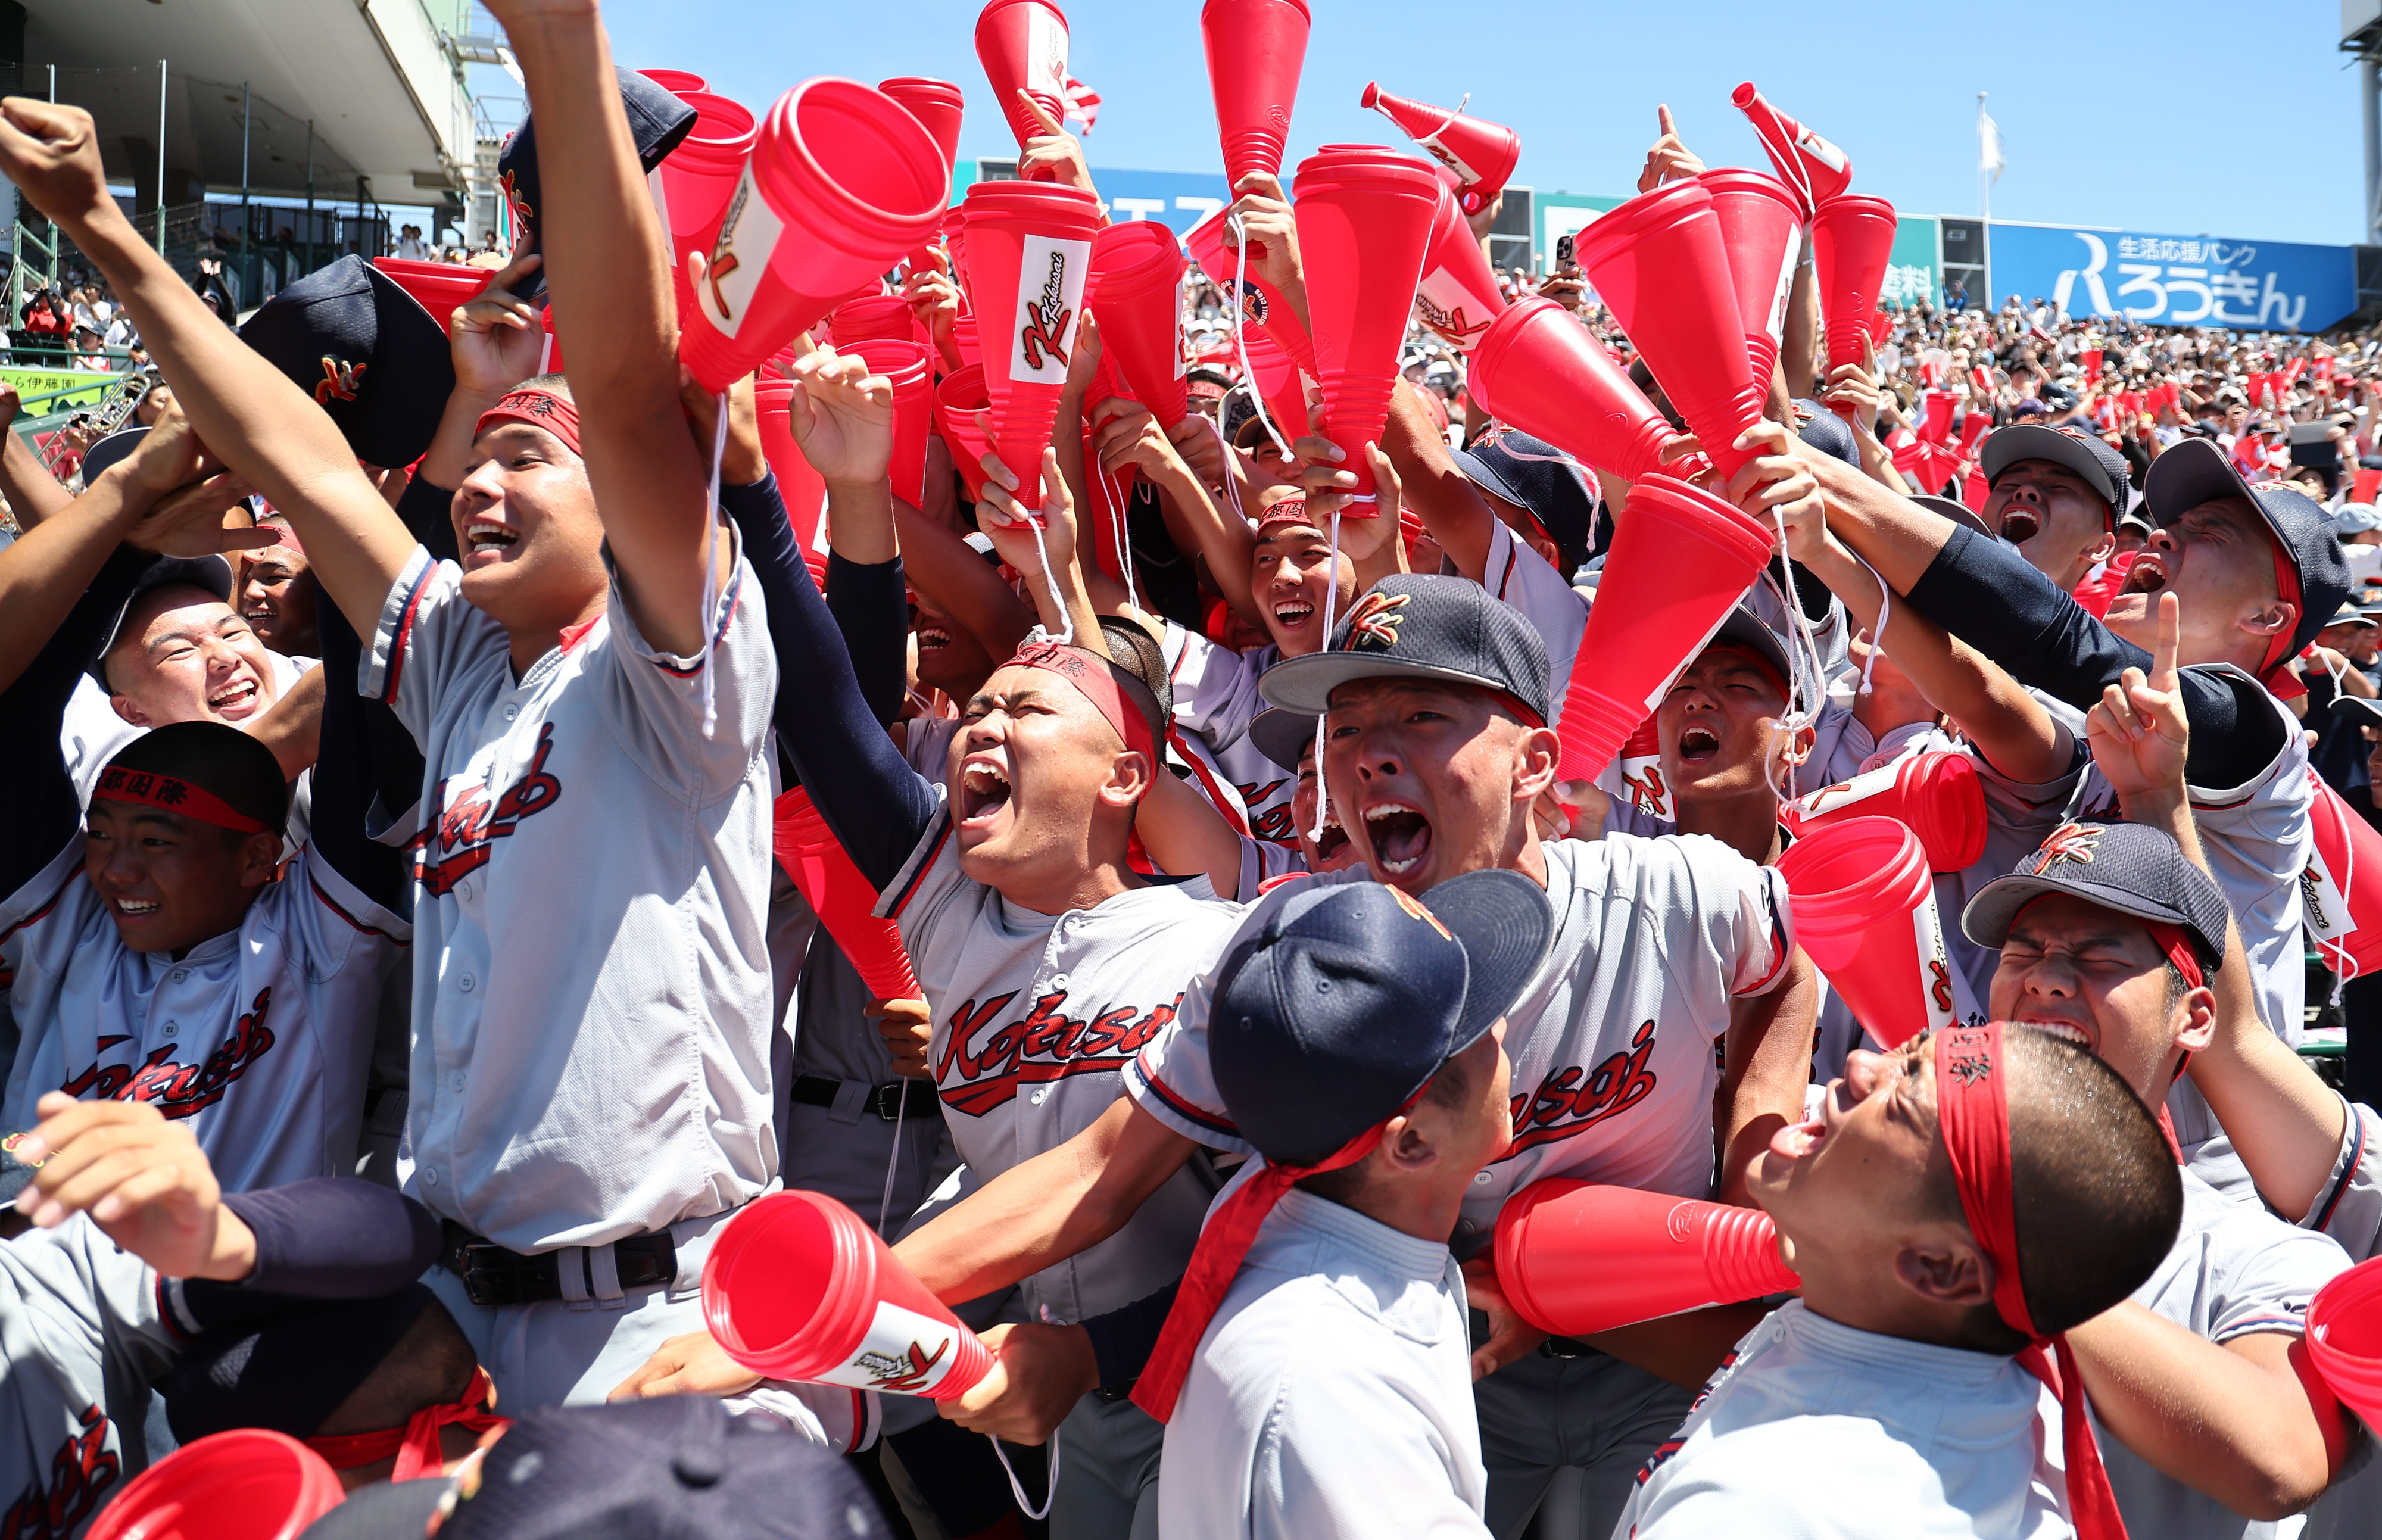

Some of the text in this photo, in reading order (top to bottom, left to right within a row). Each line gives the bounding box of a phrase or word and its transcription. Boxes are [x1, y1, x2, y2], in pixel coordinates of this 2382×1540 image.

[2116, 236, 2256, 266] 生活応援バンク
[1040, 248, 1065, 325] Kokusai
[1254, 288, 1267, 305] CLUB
[2117, 263, 2306, 327] ろうきん
[100, 769, 189, 805] 都国際
